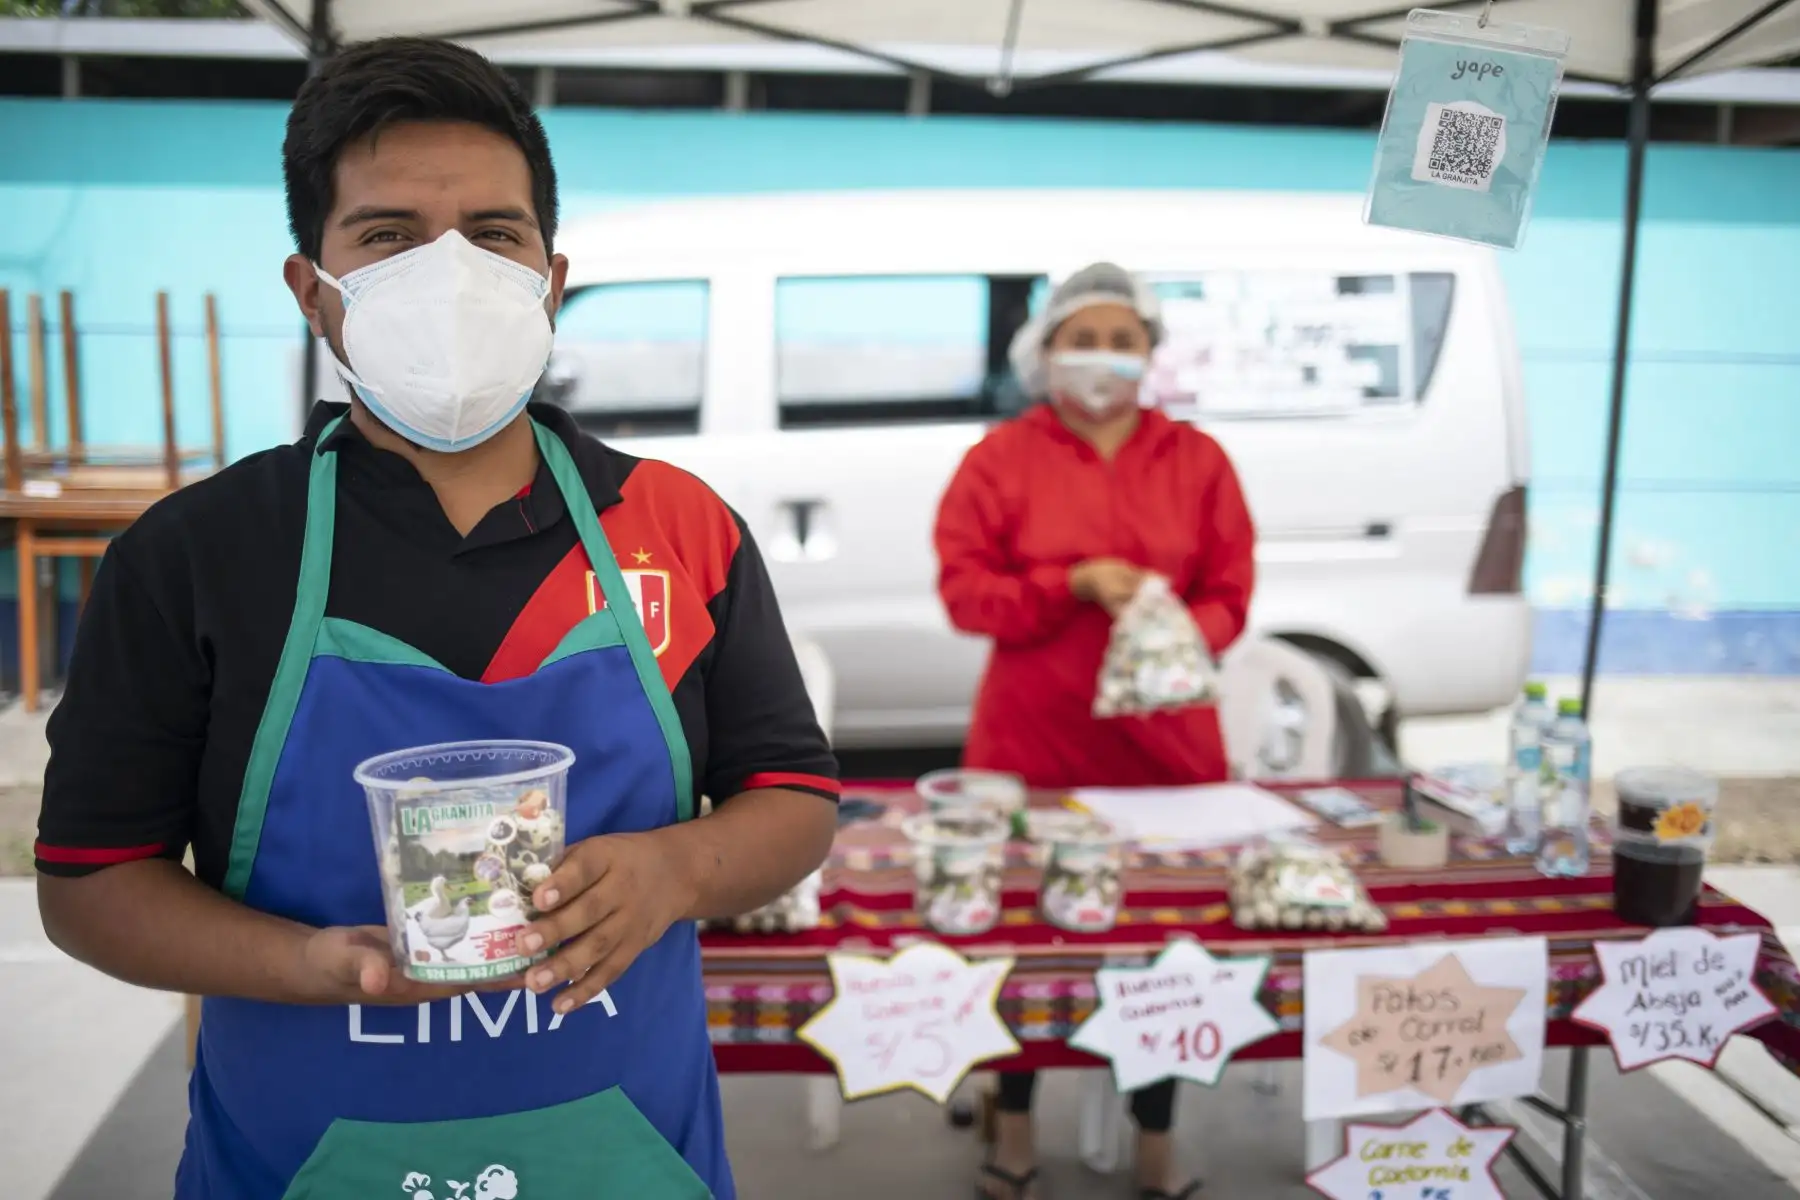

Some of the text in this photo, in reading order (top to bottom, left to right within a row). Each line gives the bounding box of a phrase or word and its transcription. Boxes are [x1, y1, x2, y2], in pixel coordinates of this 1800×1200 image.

[1451, 60, 1504, 81] yape
[1431, 171, 1479, 186] LA GRANJITA
[401, 802, 494, 835] LA GRANJITA
[1620, 945, 1725, 988] Miel de
[349, 988, 618, 1043] LIMA
